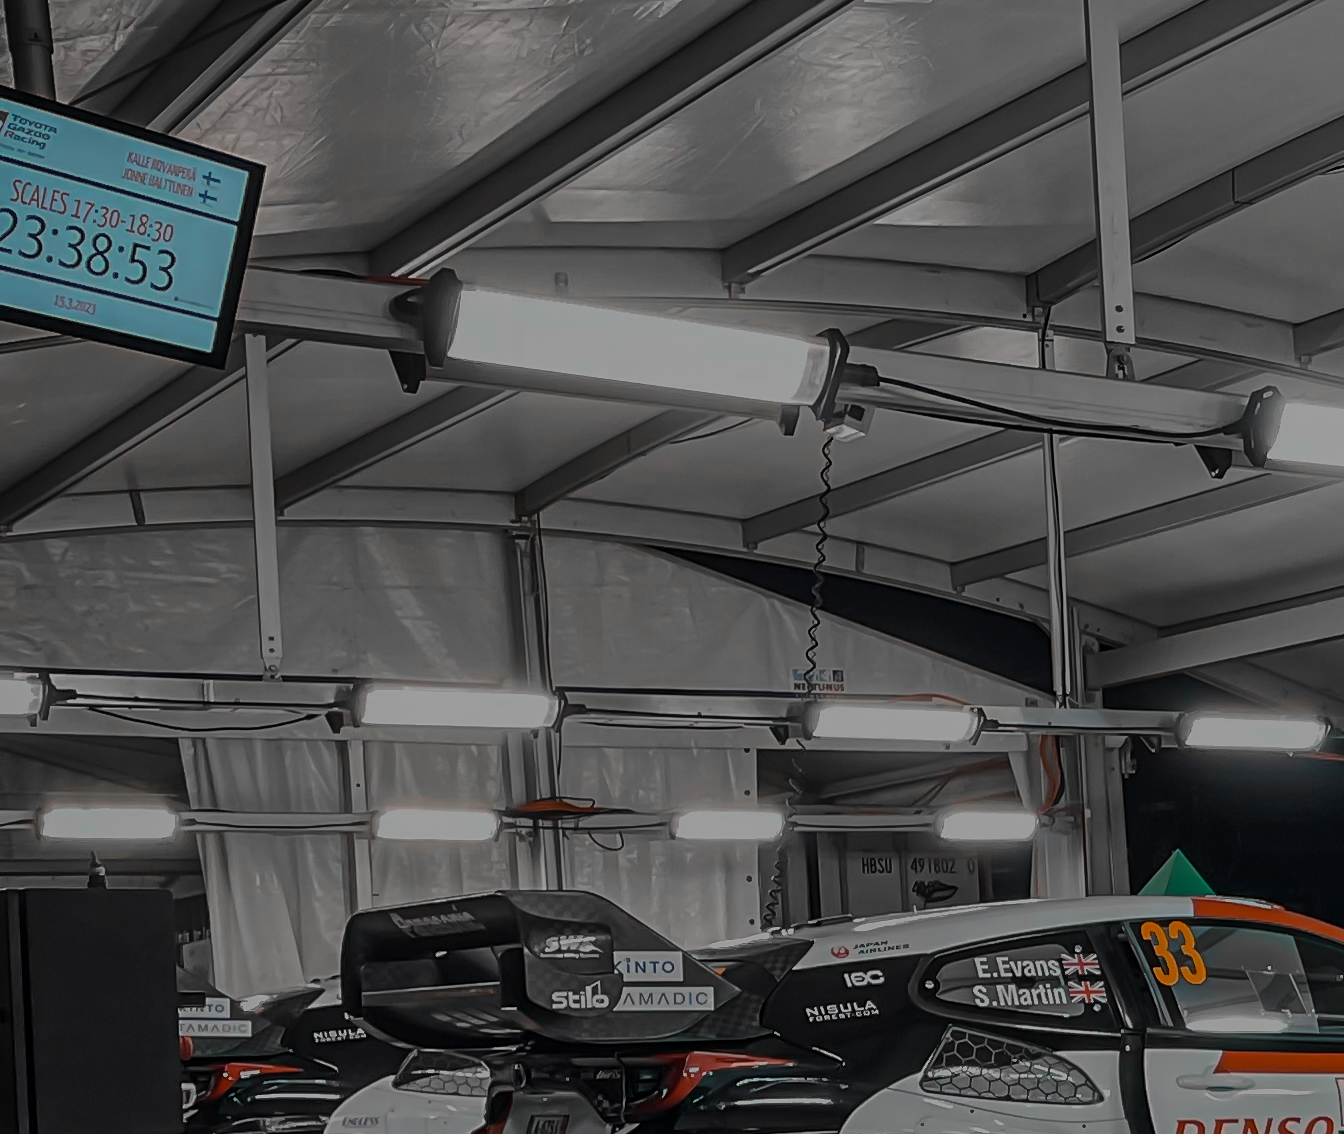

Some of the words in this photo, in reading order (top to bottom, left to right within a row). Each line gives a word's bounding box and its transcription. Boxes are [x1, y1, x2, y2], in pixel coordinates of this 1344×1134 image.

[127, 151, 150, 168] KALLE
[9, 178, 70, 215] SCALES
[70, 199, 175, 243] 17:30-18:30
[0, 207, 176, 292] 23:38:53
[861, 857, 893, 874] HBSU
[853, 940, 889, 950] JAPAN
[858, 944, 910, 955] AIRLINES
[1140, 920, 1208, 987] 33
[973, 956, 1062, 979] E.Evans
[551, 980, 611, 1010] Stilo
[972, 984, 1068, 1008] S.Martin
[805, 1000, 878, 1017] NISULA
